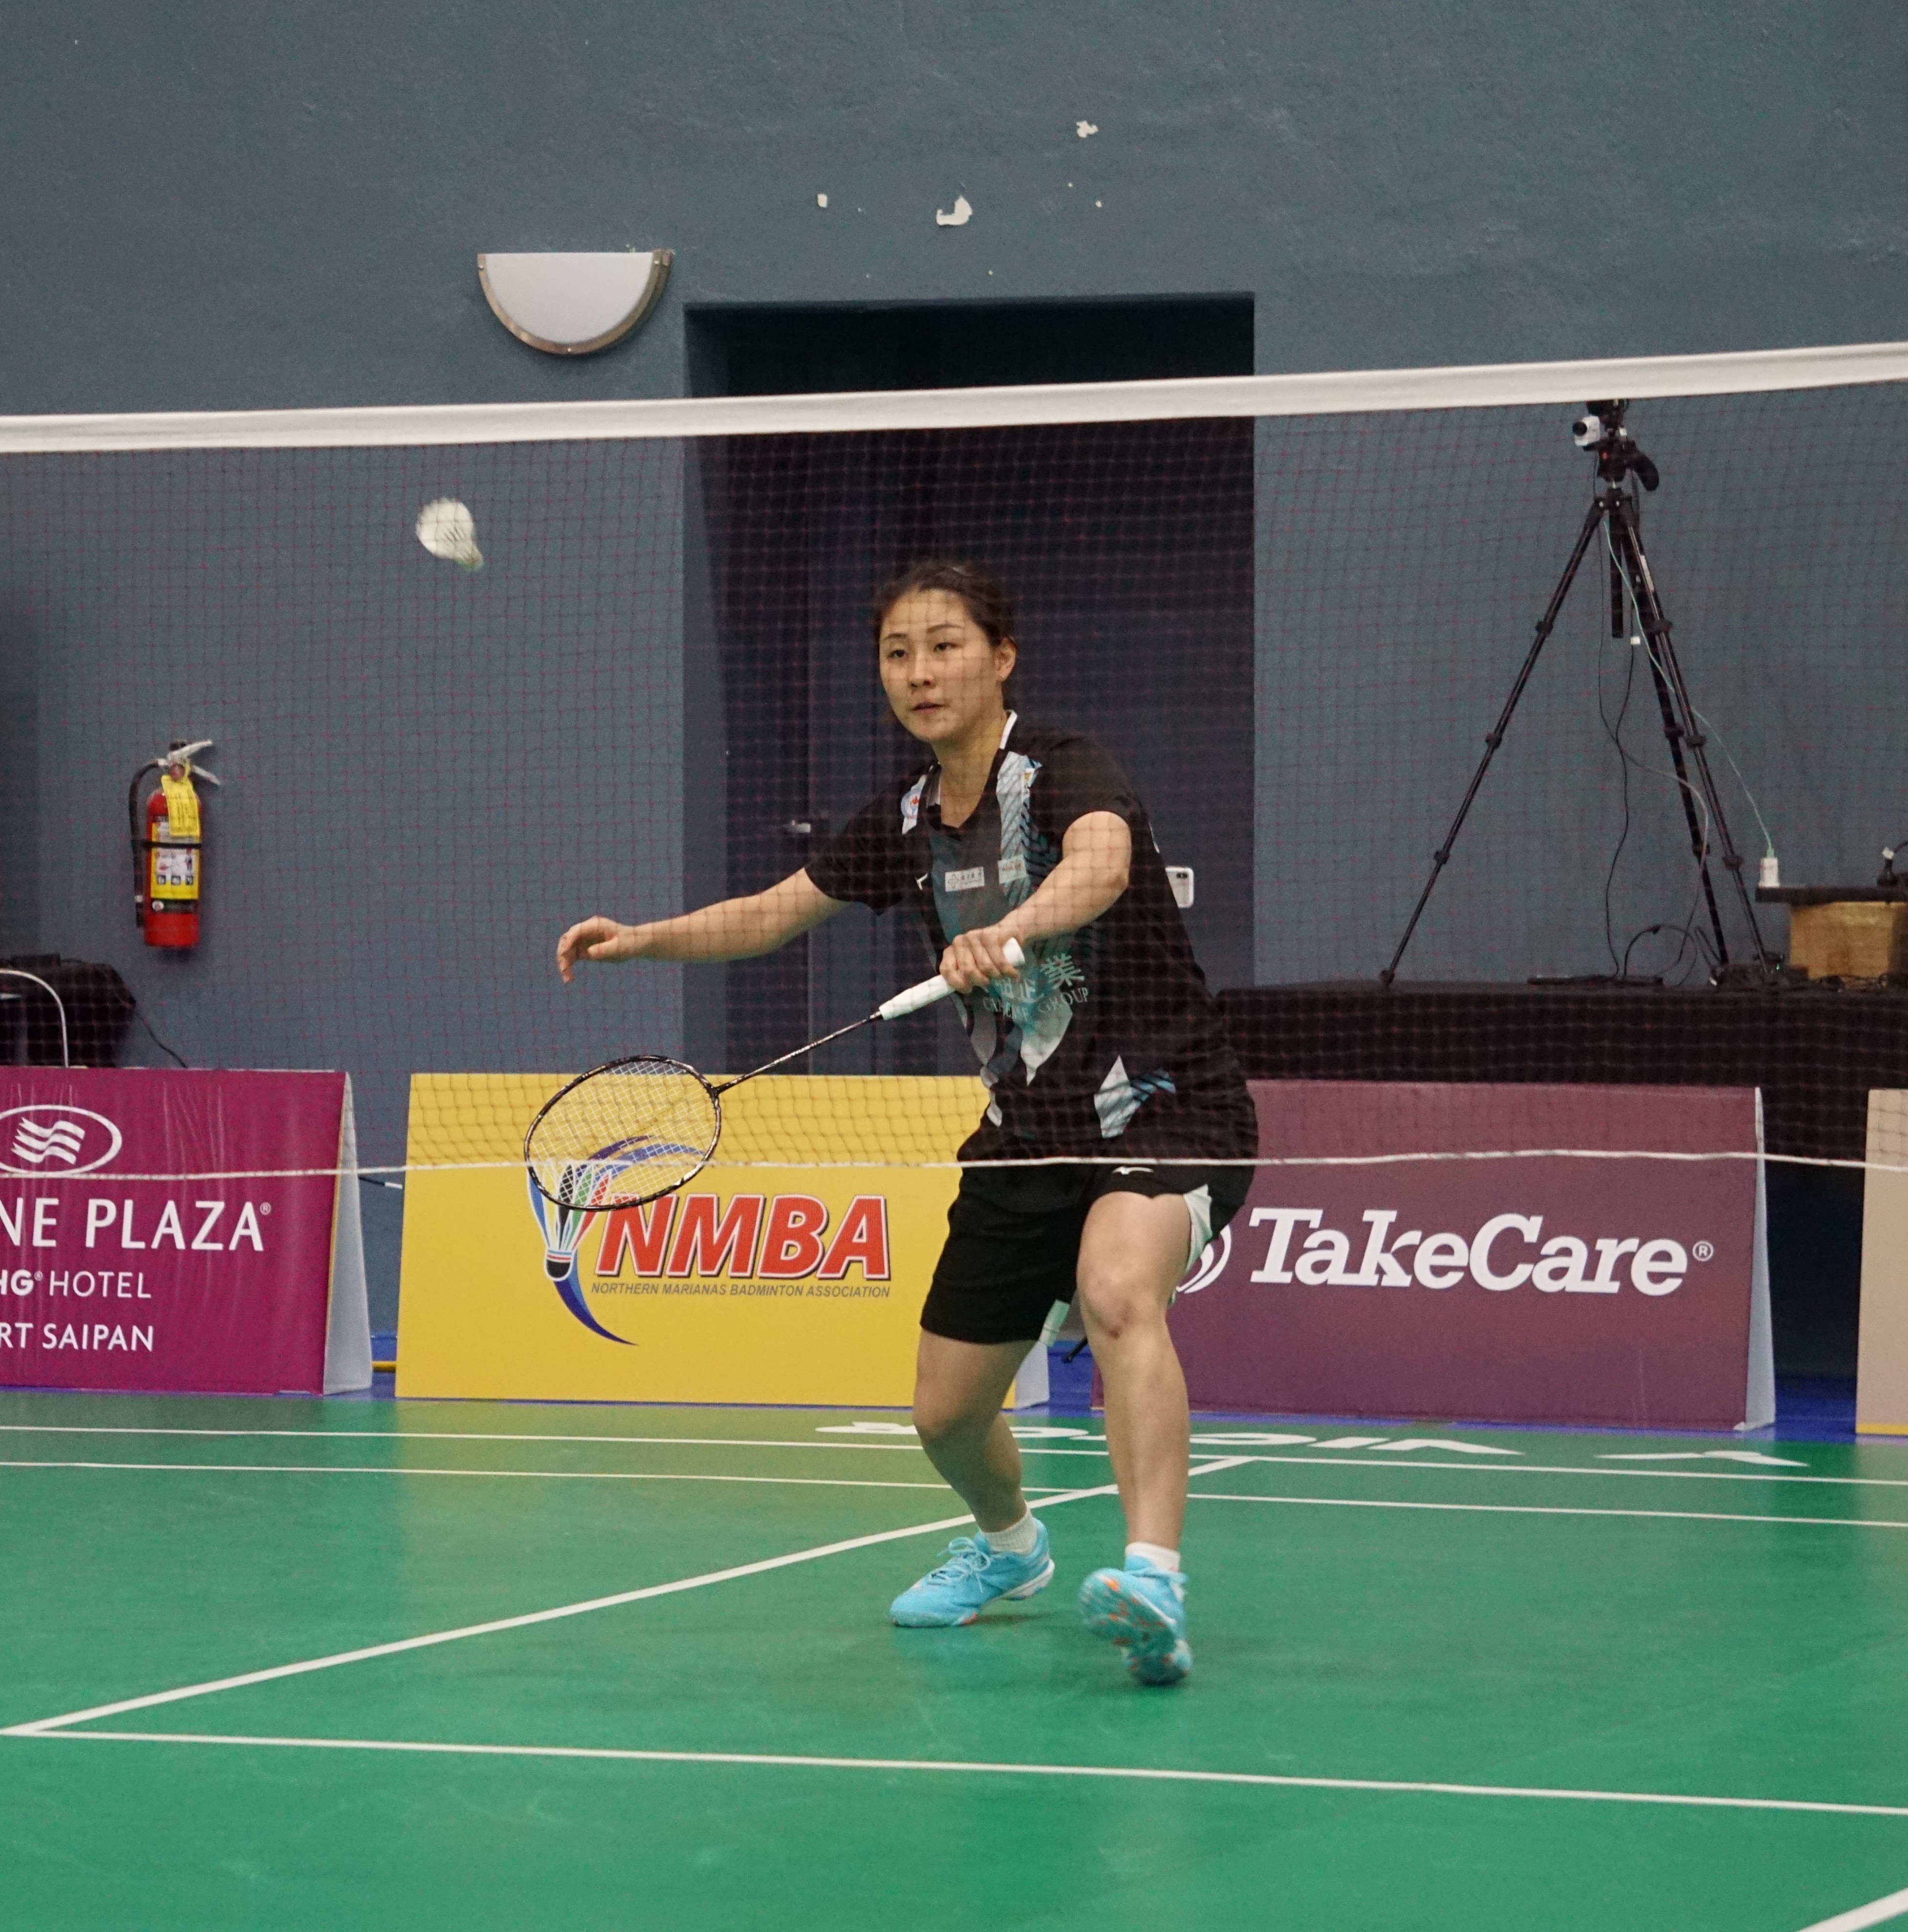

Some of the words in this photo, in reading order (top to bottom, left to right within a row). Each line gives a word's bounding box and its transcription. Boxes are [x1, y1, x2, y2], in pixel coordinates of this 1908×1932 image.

[594, 1193, 891, 1281] NMBA
[49, 1270, 152, 1298] HOTEL
[591, 1282, 660, 1294] NORTHERN
[662, 1284, 727, 1295] MARIANAS
[730, 1284, 804, 1296] BADMINTON
[806, 1286, 891, 1298] ASSOCIATION
[42, 1323, 153, 1352] SAIPAN
[815, 1421, 1524, 1455] VICOR
